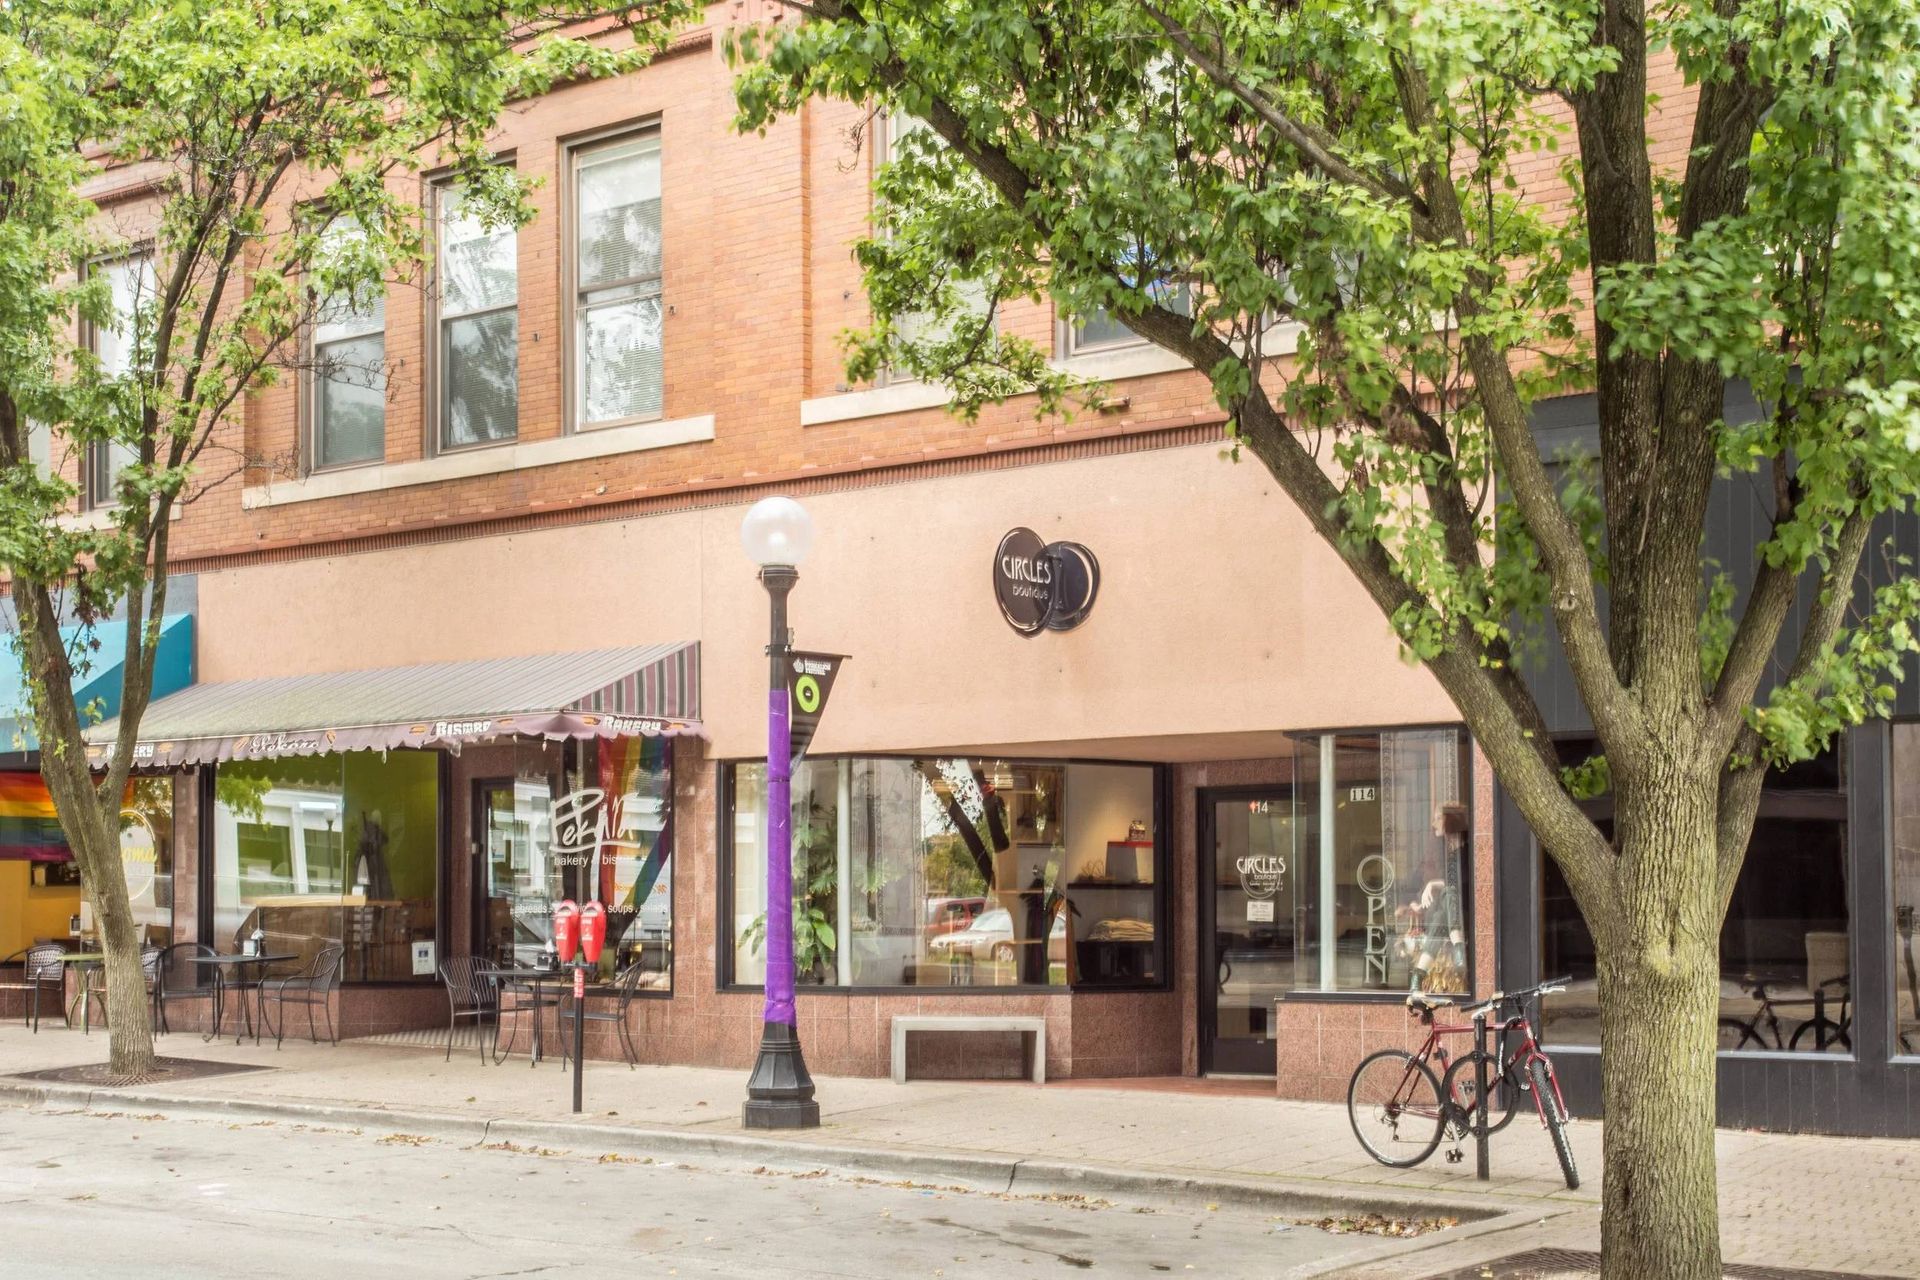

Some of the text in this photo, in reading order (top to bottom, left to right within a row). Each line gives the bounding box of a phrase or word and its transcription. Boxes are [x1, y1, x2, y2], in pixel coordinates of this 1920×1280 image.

[1002, 556, 1051, 584] CIRCLES
[1013, 586, 1048, 600] boutique
[604, 716, 661, 731] BAKERY
[1352, 788, 1375, 800] 114
[1250, 801, 1269, 814] 114
[554, 855, 588, 868] bakery
[1236, 857, 1286, 874] CIRCLES
[608, 904, 633, 915] soups
[1356, 855, 1394, 984] OPEN
